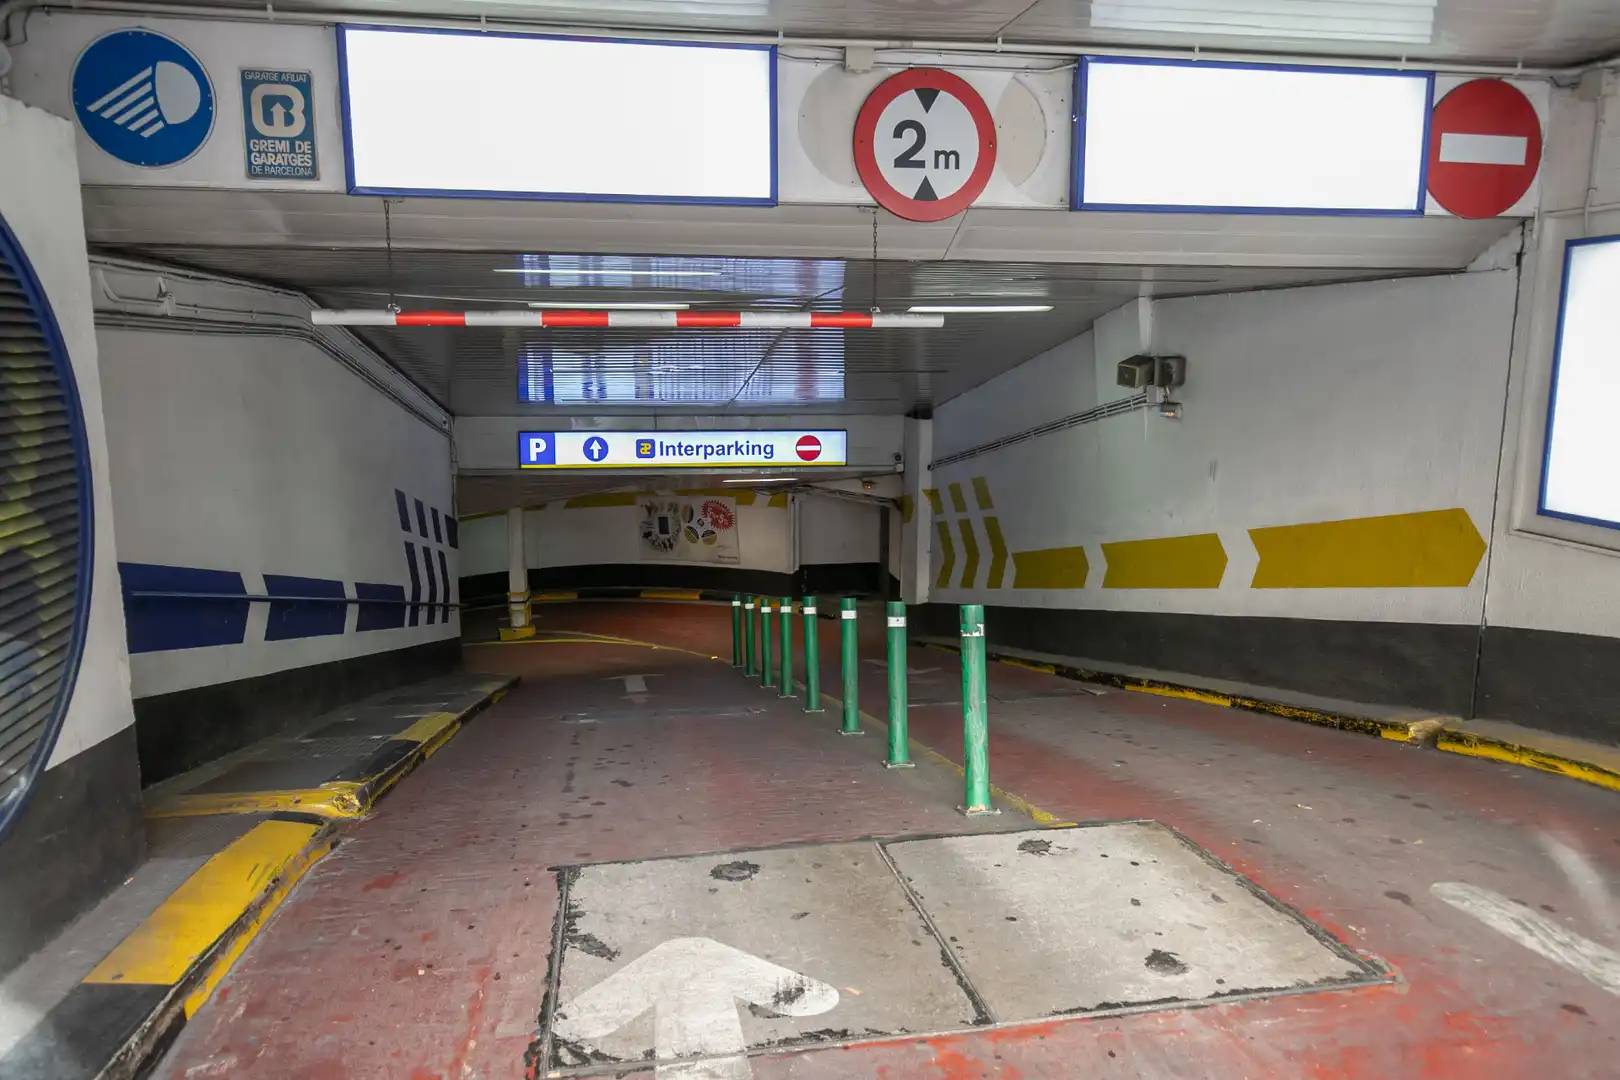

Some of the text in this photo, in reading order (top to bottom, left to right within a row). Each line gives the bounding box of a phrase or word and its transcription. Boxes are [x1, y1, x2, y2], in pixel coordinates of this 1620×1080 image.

[244, 71, 308, 83] GARATGE AFILIAT
[250, 139, 312, 154] GREMI DE
[892, 119, 960, 170] 2 m
[251, 152, 312, 167] GARATGES
[251, 165, 313, 177] DE BARCELONA
[529, 438, 774, 462] P Interparking
